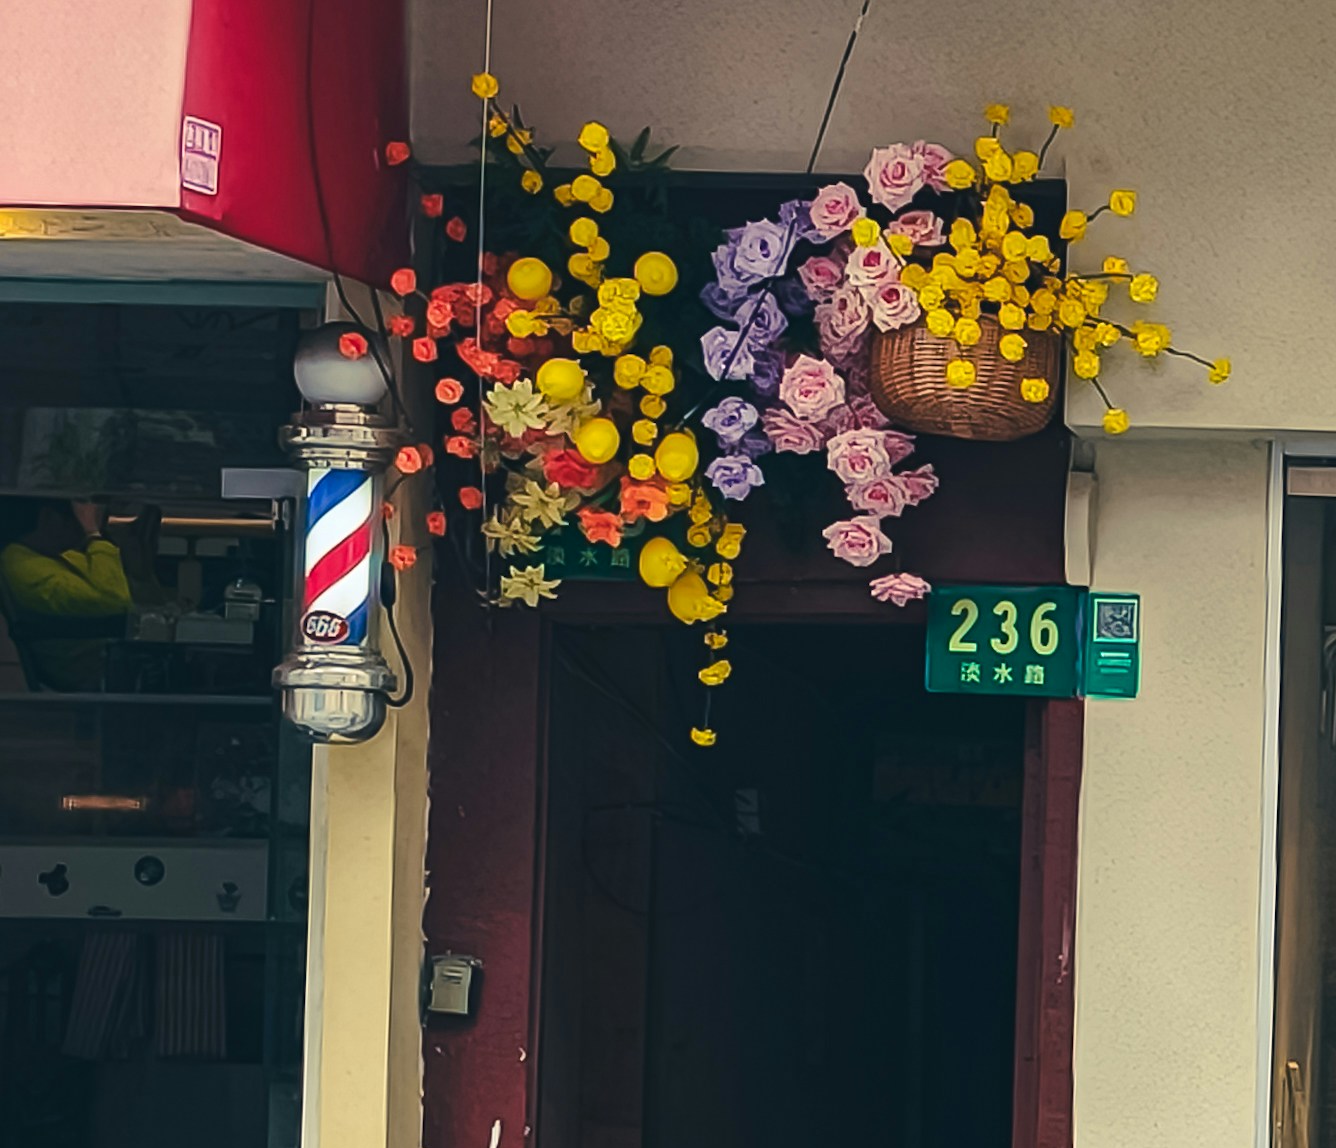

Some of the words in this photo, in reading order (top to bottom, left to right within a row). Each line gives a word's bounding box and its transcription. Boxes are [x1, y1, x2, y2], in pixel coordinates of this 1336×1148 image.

[948, 598, 1059, 655] 236
[960, 662, 1045, 685] 淡水路
